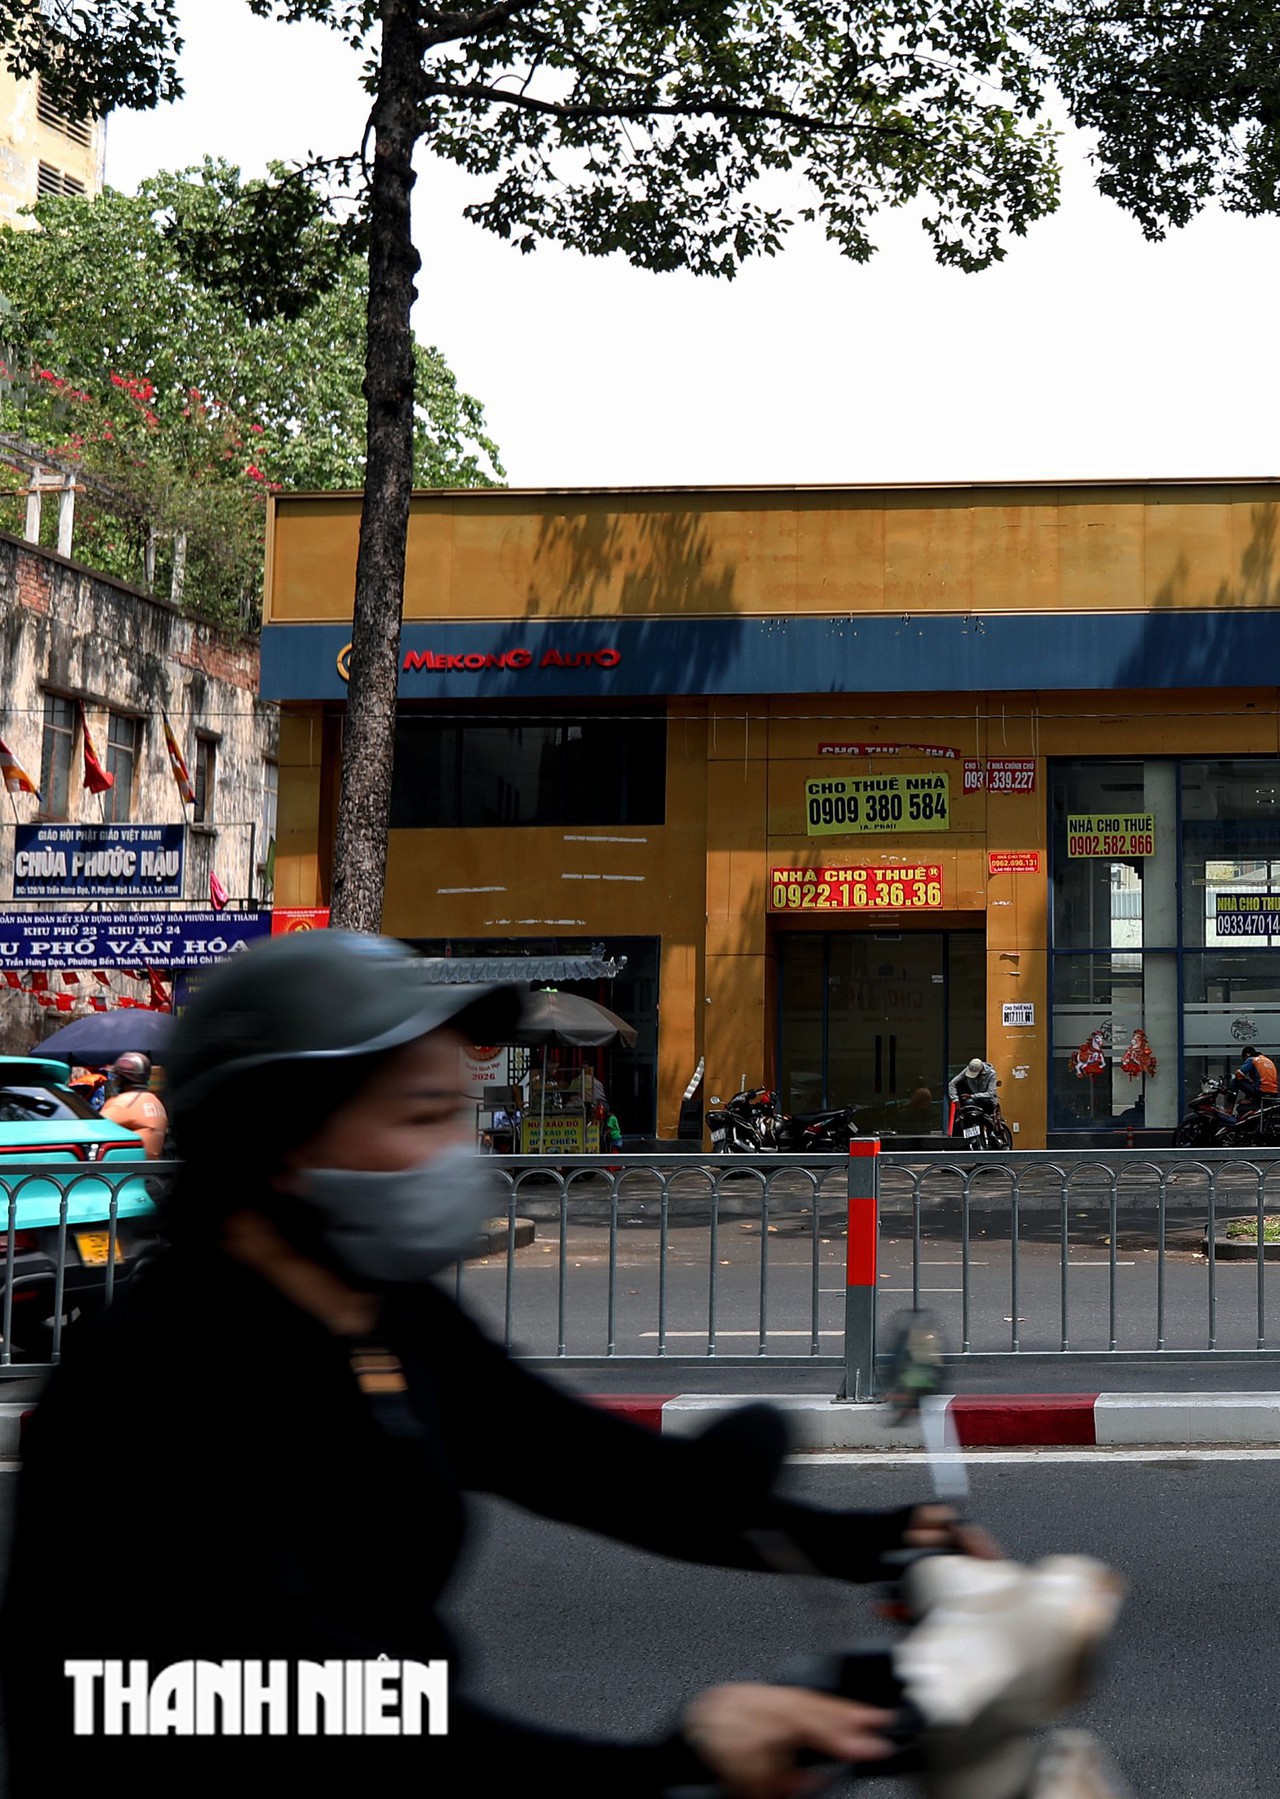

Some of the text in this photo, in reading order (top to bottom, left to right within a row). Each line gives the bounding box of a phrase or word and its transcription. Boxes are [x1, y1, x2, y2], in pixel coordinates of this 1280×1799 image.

[808, 775, 945, 795] CHO THUÊ NHÀ
[809, 793, 946, 825] 0909 380 584
[1069, 815, 1152, 833] NHÀ CHO THUÊ
[38, 828, 58, 841] GIÁO
[60, 829, 74, 842] HỘI
[99, 828, 119, 841] GIÁO
[121, 828, 140, 842] VIỆT
[141, 830, 162, 840] NAM
[1069, 835, 1153, 856] 0902.582.966
[16, 846, 179, 881] CHÙA PHƯỚC HẬU
[773, 869, 817, 882] NHÀ
[824, 870, 866, 881] CHO
[874, 867, 926, 880] THUÊ
[773, 882, 941, 907] 0922.16.36.36
[1217, 895, 1238, 911] NHÀ
[1239, 897, 1260, 911] CHO
[23, 926, 50, 936] KHU
[82, 926, 97, 935] 23
[108, 926, 135, 935] KHU
[166, 926, 180, 934] 24
[30, 936, 98, 955] PHỐ
[106, 937, 173, 954] VĂN
[183, 936, 250, 953] HÓA
